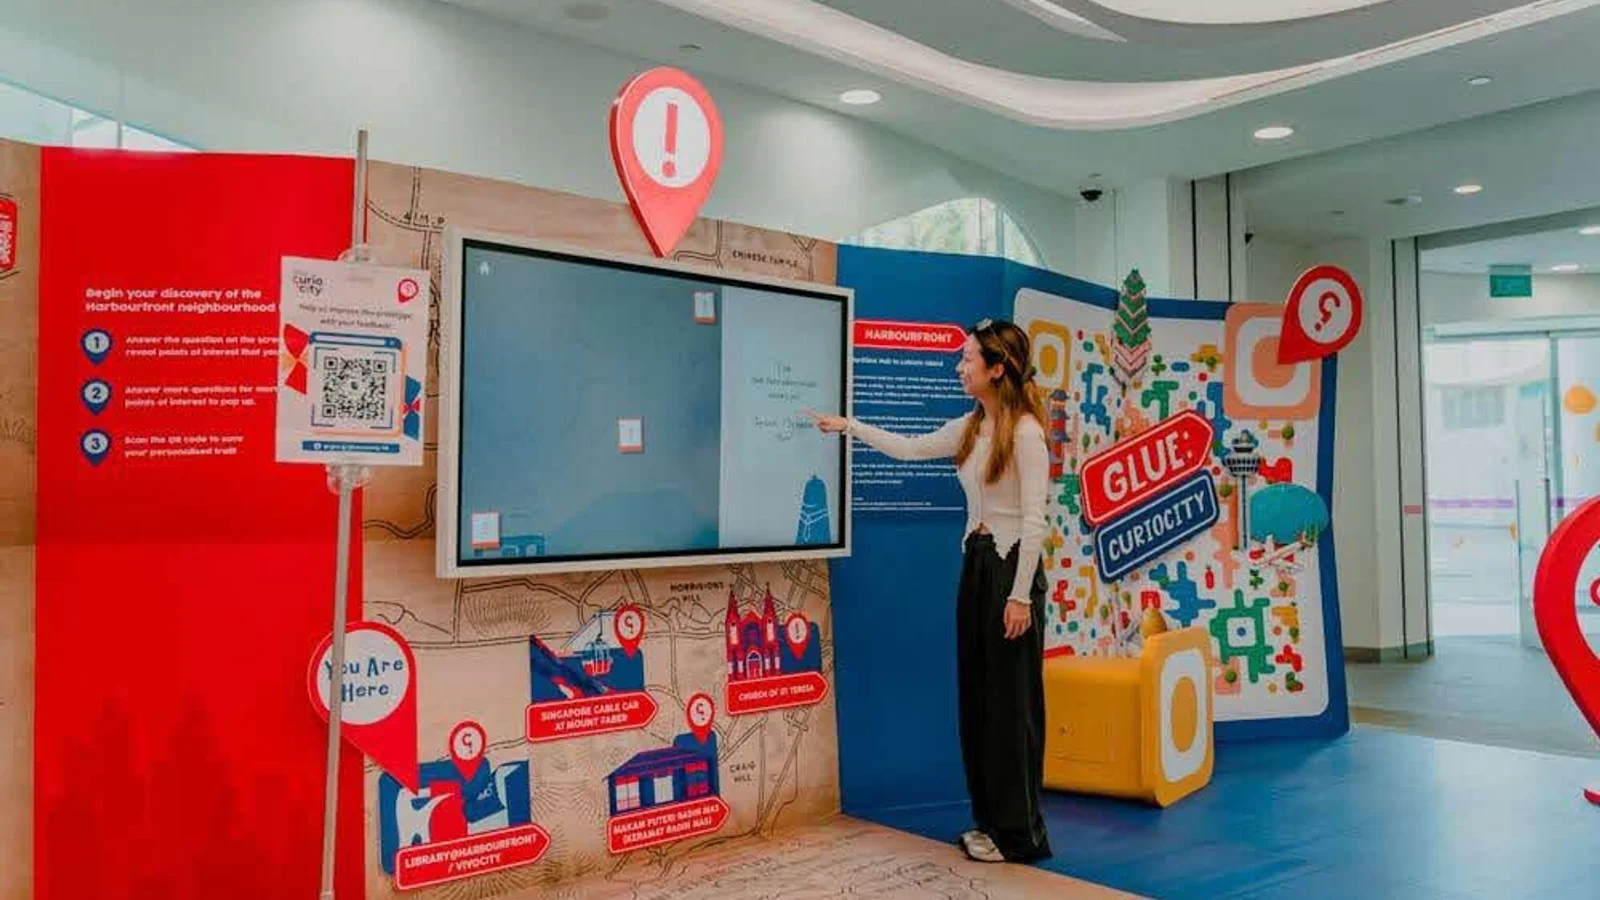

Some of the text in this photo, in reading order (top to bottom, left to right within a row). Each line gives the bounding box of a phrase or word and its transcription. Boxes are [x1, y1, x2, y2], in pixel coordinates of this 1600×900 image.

[292, 274, 323, 286] curio
[86, 287, 262, 302] Begin your discovery of the
[297, 284, 323, 297] city
[85, 301, 277, 314] Harbourfront neighbourhood
[93, 336, 100, 349] 1
[126, 336, 160, 344] Answer
[182, 336, 223, 345] question
[864, 330, 952, 343] HARBOURFRONT
[158, 348, 189, 357] points
[190, 348, 201, 356] of
[202, 348, 239, 356] interest
[240, 348, 261, 356] that
[92, 387, 102, 399] 2
[125, 386, 160, 394] Answer
[191, 386, 237, 395] questions
[239, 385, 253, 393] for
[124, 398, 156, 409] points
[157, 398, 168, 406] of
[169, 398, 207, 406] interest
[220, 399, 240, 408] pop
[91, 437, 101, 450] 3
[125, 436, 149, 444] Scan
[150, 436, 166, 444] the
[183, 436, 207, 444] code
[125, 449, 149, 458] your
[150, 448, 213, 458] personalised
[1103, 431, 1193, 502] GLUE:
[1108, 490, 1206, 561] CURIOCITY
[367, 657, 404, 678] Are
[341, 683, 389, 703] Here
[738, 690, 770, 702] CHURCH
[770, 689, 779, 698] OF
[789, 684, 815, 695] TERESA
[541, 701, 640, 720] SINGAPORE CABLE CAR
[556, 713, 628, 731] AT MOUNT FABER
[613, 820, 646, 836] MAKAM
[647, 813, 677, 828] PUTERI
[677, 808, 699, 823] RADIN
[666, 821, 691, 834] RADIN
[404, 833, 538, 869] LIBRARY@HARBOURFRONT
[454, 853, 501, 871] VIVOCITY
